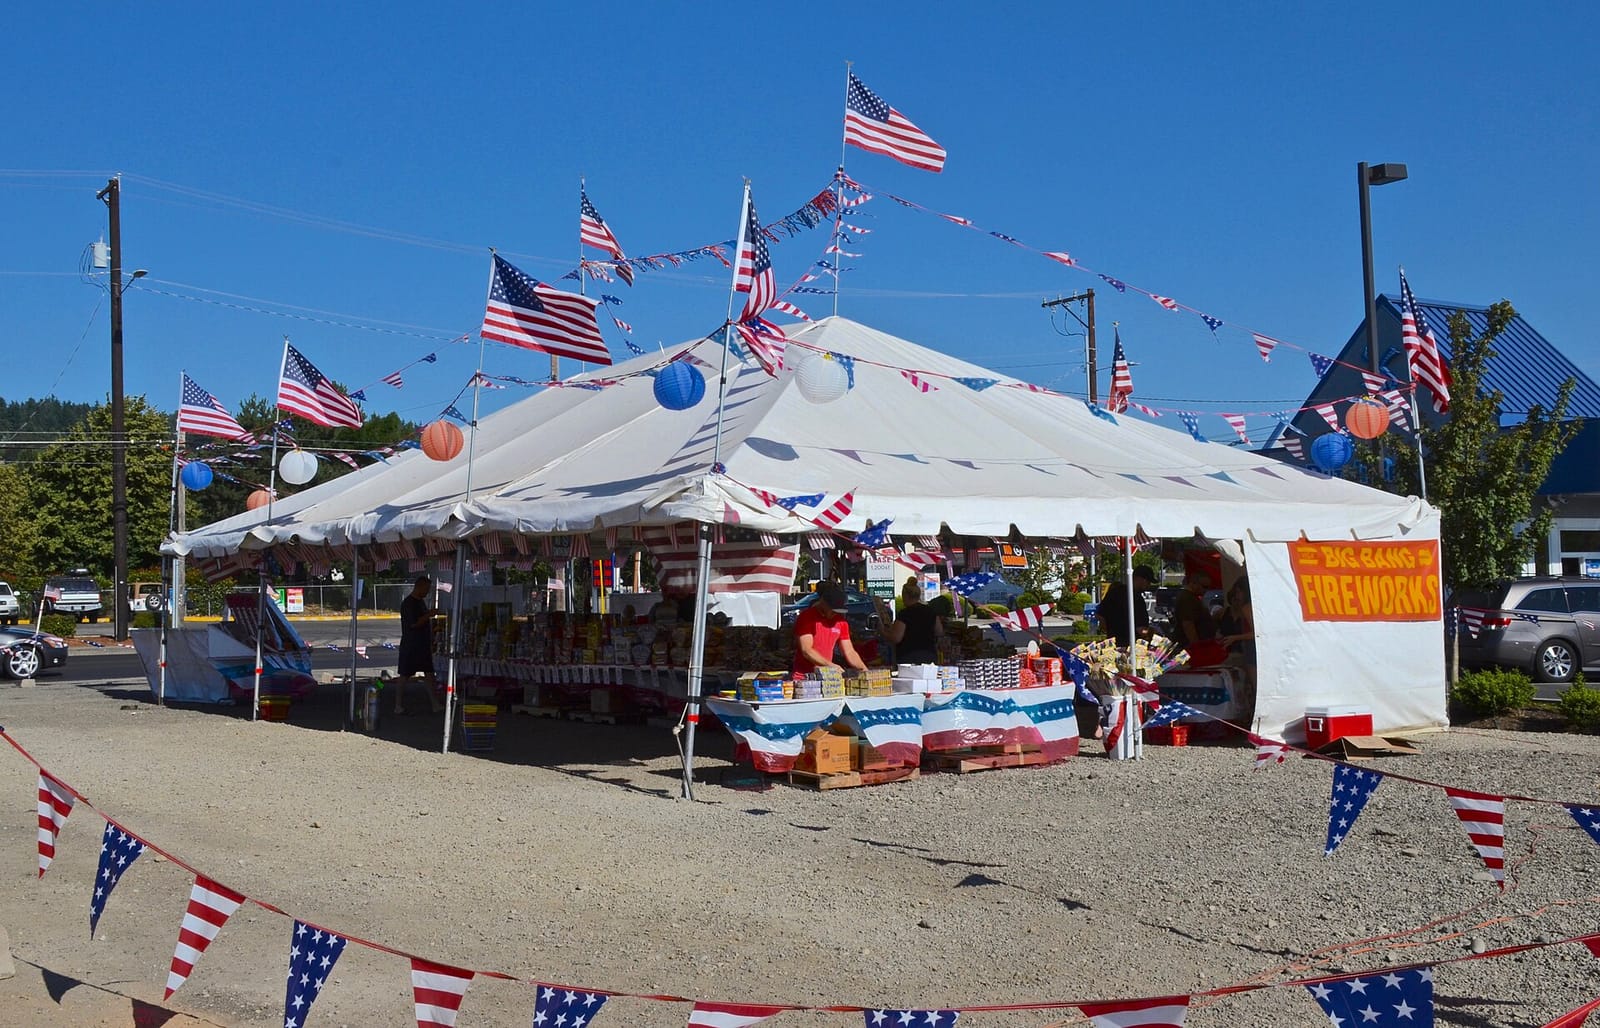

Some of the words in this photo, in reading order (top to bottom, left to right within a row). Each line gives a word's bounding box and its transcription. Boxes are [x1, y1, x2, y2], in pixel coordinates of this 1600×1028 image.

[1321, 546, 1360, 568] BIG
[1360, 547, 1415, 568] BANG
[1300, 574, 1438, 615] FIREWORKS
